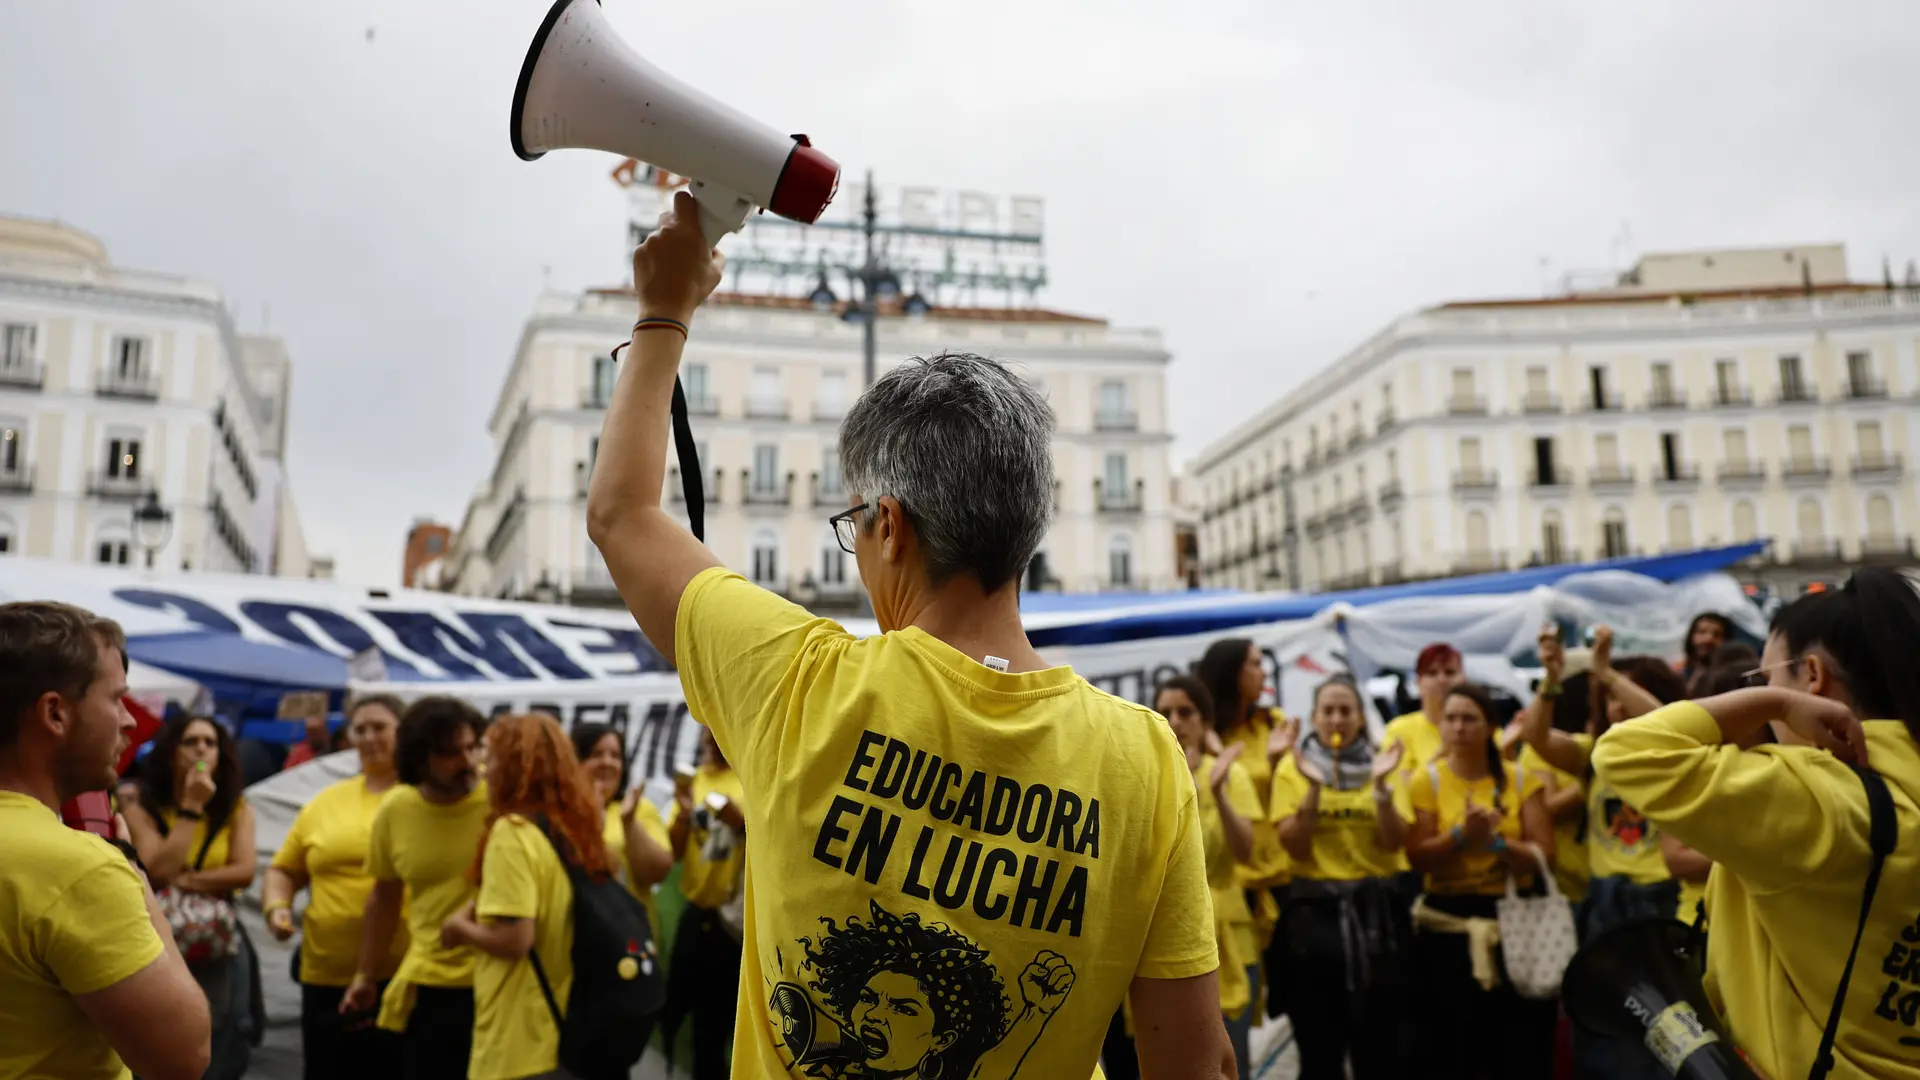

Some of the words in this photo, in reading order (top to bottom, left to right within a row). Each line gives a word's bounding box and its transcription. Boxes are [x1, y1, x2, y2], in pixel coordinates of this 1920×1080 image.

[844, 730, 1099, 858] EDUCADORA
[813, 795, 901, 885] EN
[901, 826, 1088, 937] LUCHA
